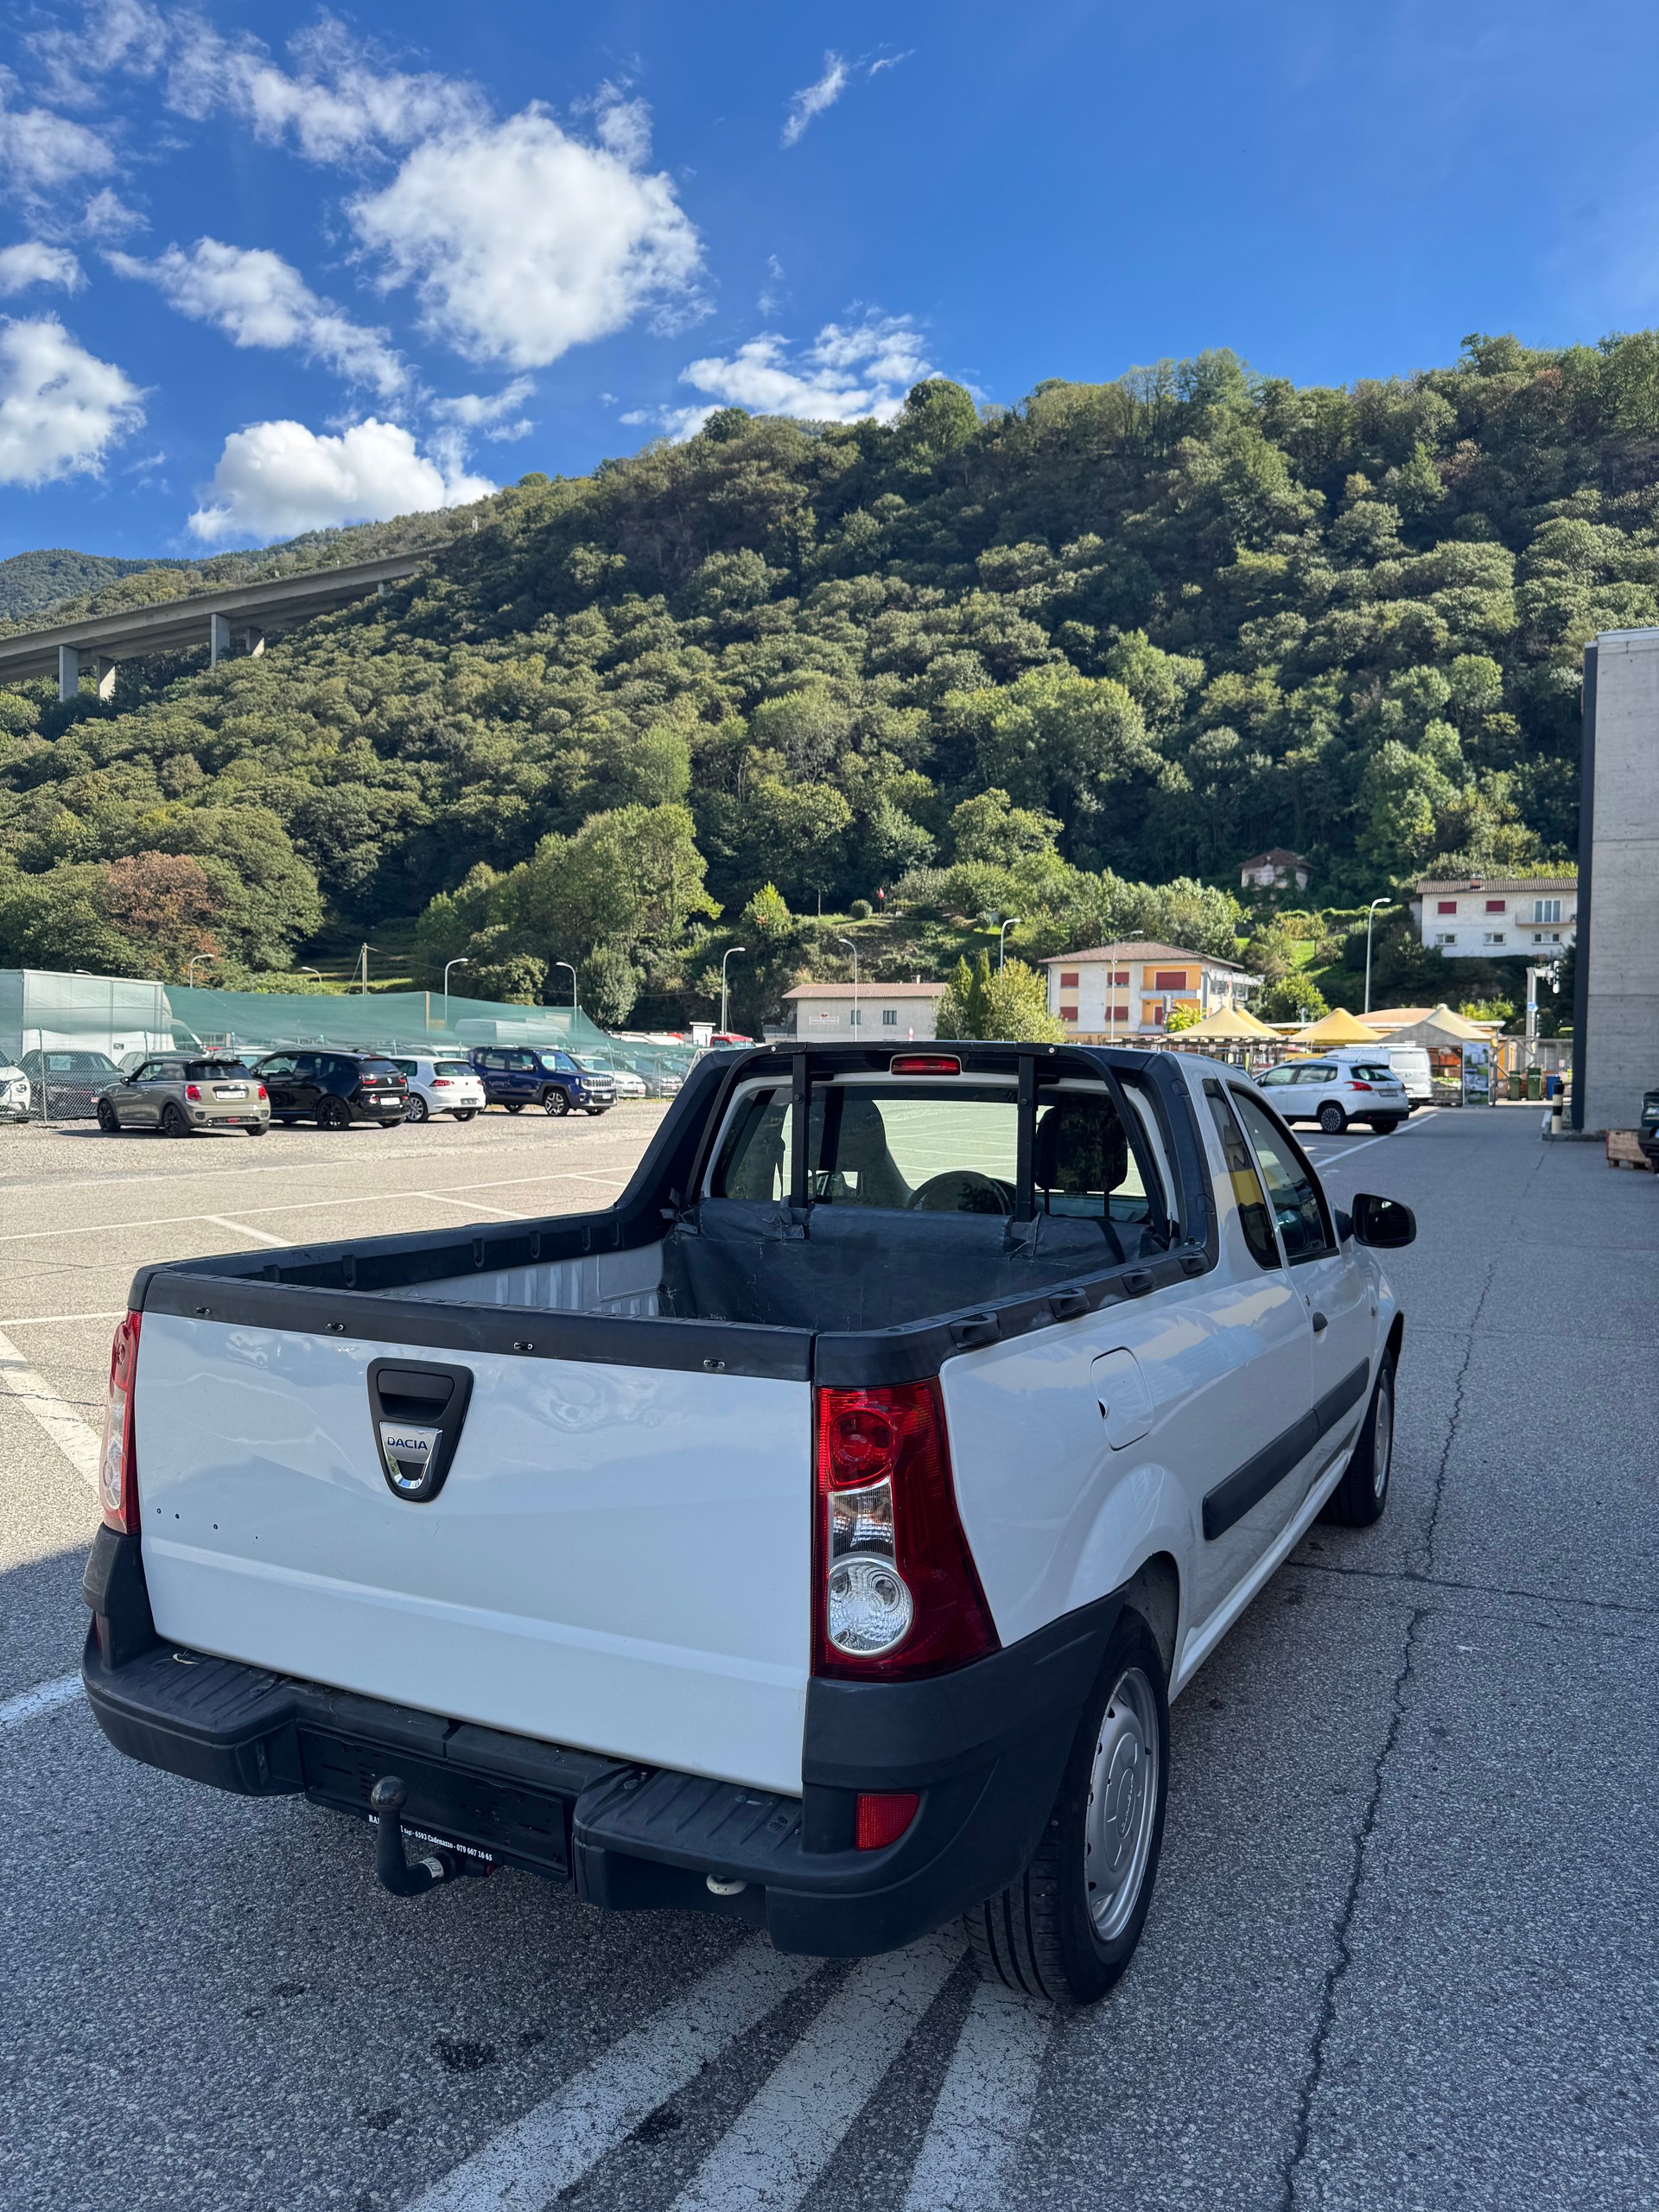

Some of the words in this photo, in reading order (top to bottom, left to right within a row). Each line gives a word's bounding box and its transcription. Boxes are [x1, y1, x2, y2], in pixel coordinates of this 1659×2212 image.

[387, 1436, 428, 1451] DACIA
[415, 1831, 427, 1840] 6593
[456, 1844, 467, 1853] 079
[467, 1847, 477, 1857] 667
[478, 1850, 485, 1859] 16
[485, 1853, 493, 1861] 65
